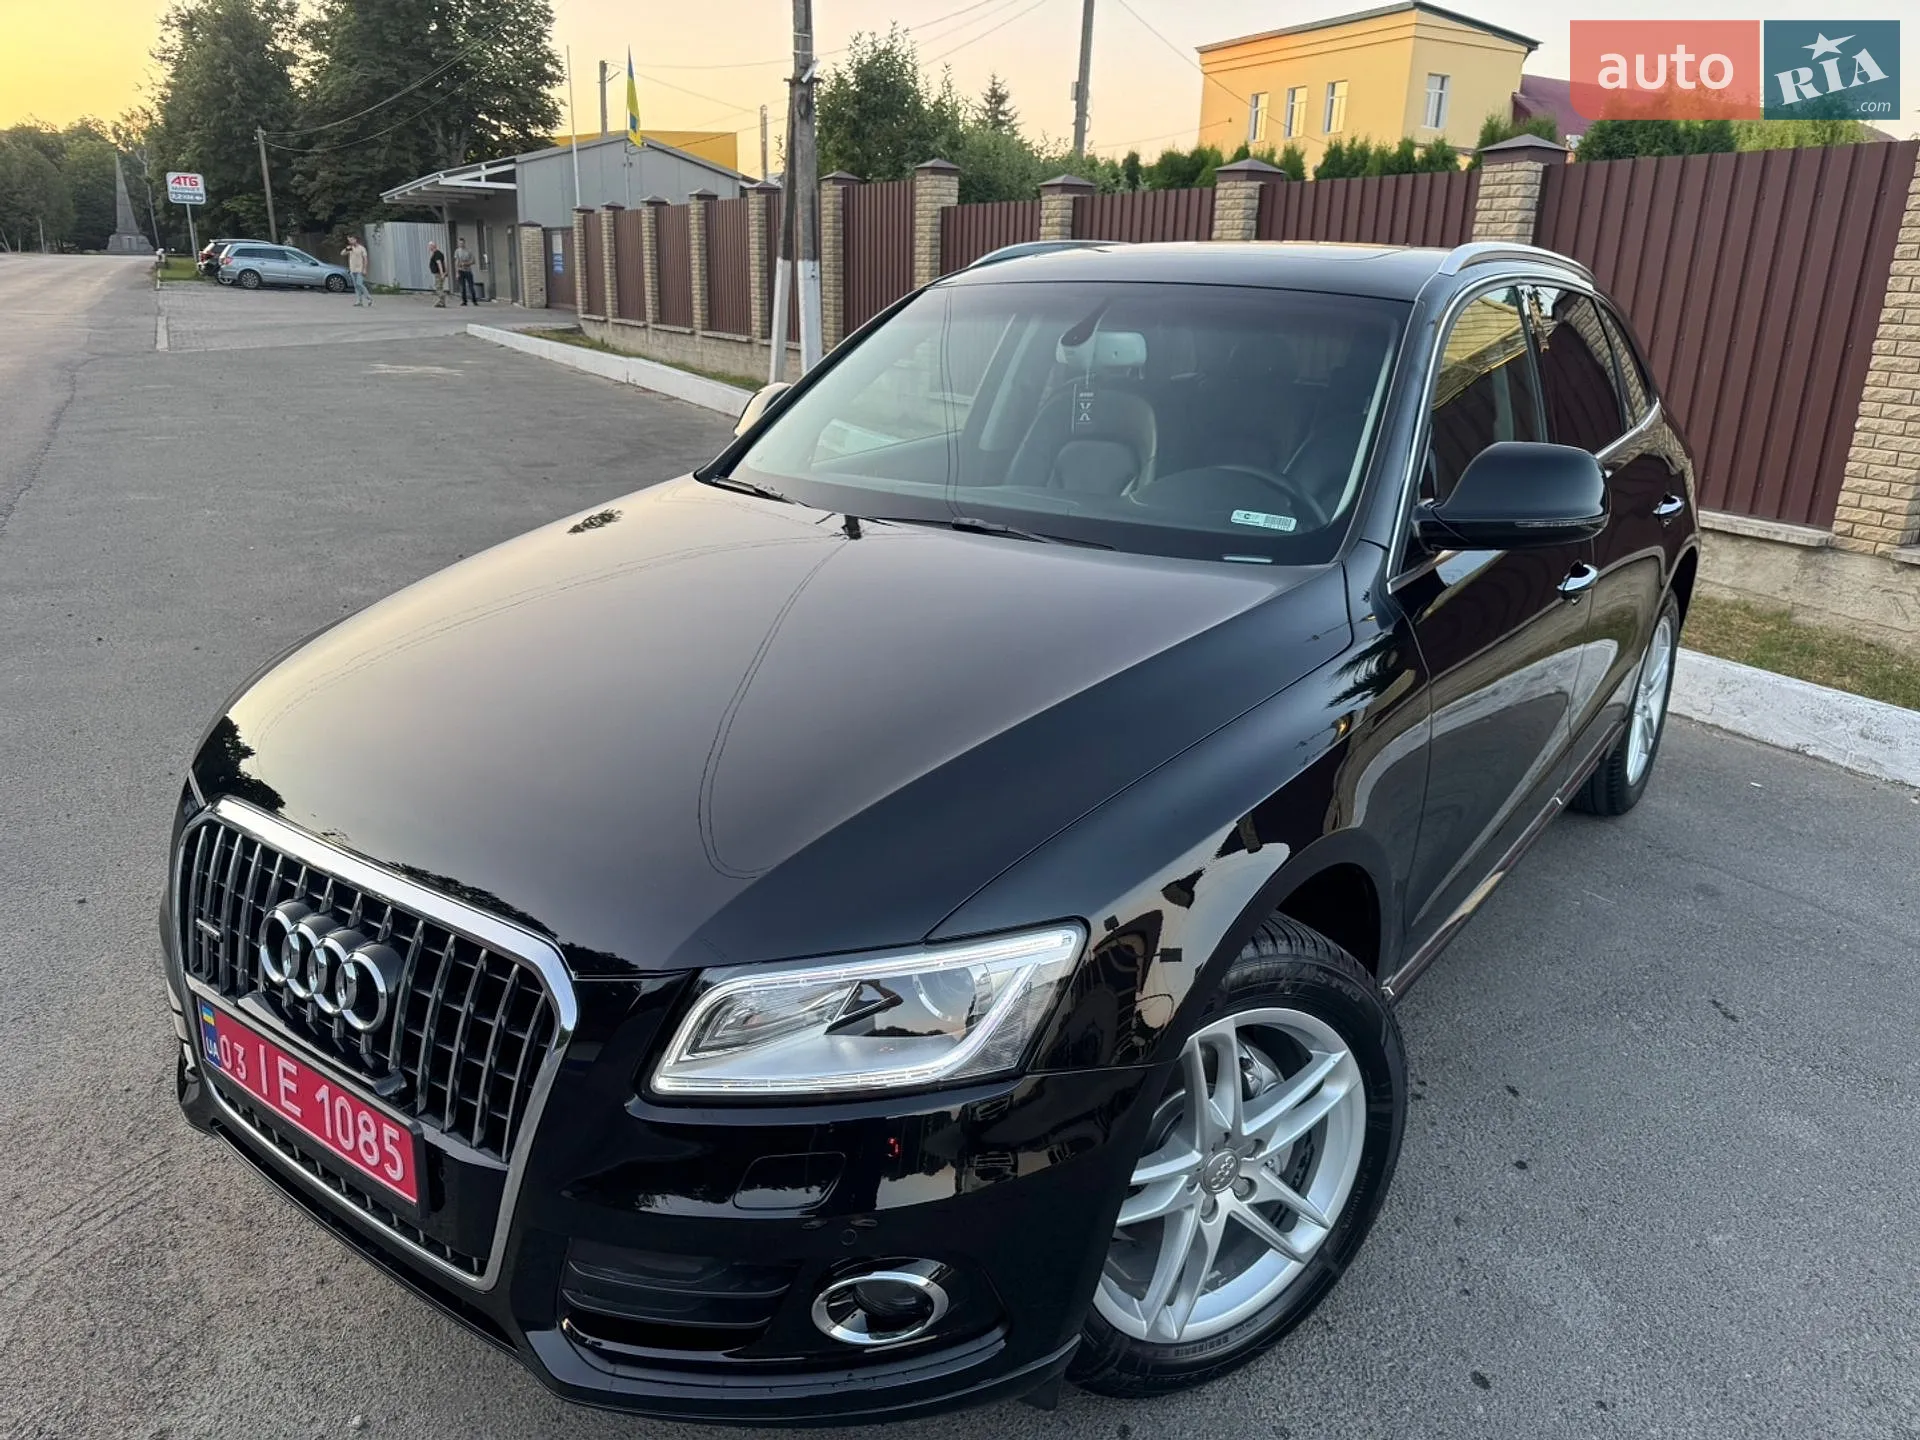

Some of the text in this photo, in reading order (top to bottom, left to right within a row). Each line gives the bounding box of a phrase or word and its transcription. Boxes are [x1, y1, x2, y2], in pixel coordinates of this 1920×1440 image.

[206, 1036, 219, 1060] UA
[220, 1035, 247, 1080] 03
[315, 1085, 404, 1181] 1085
